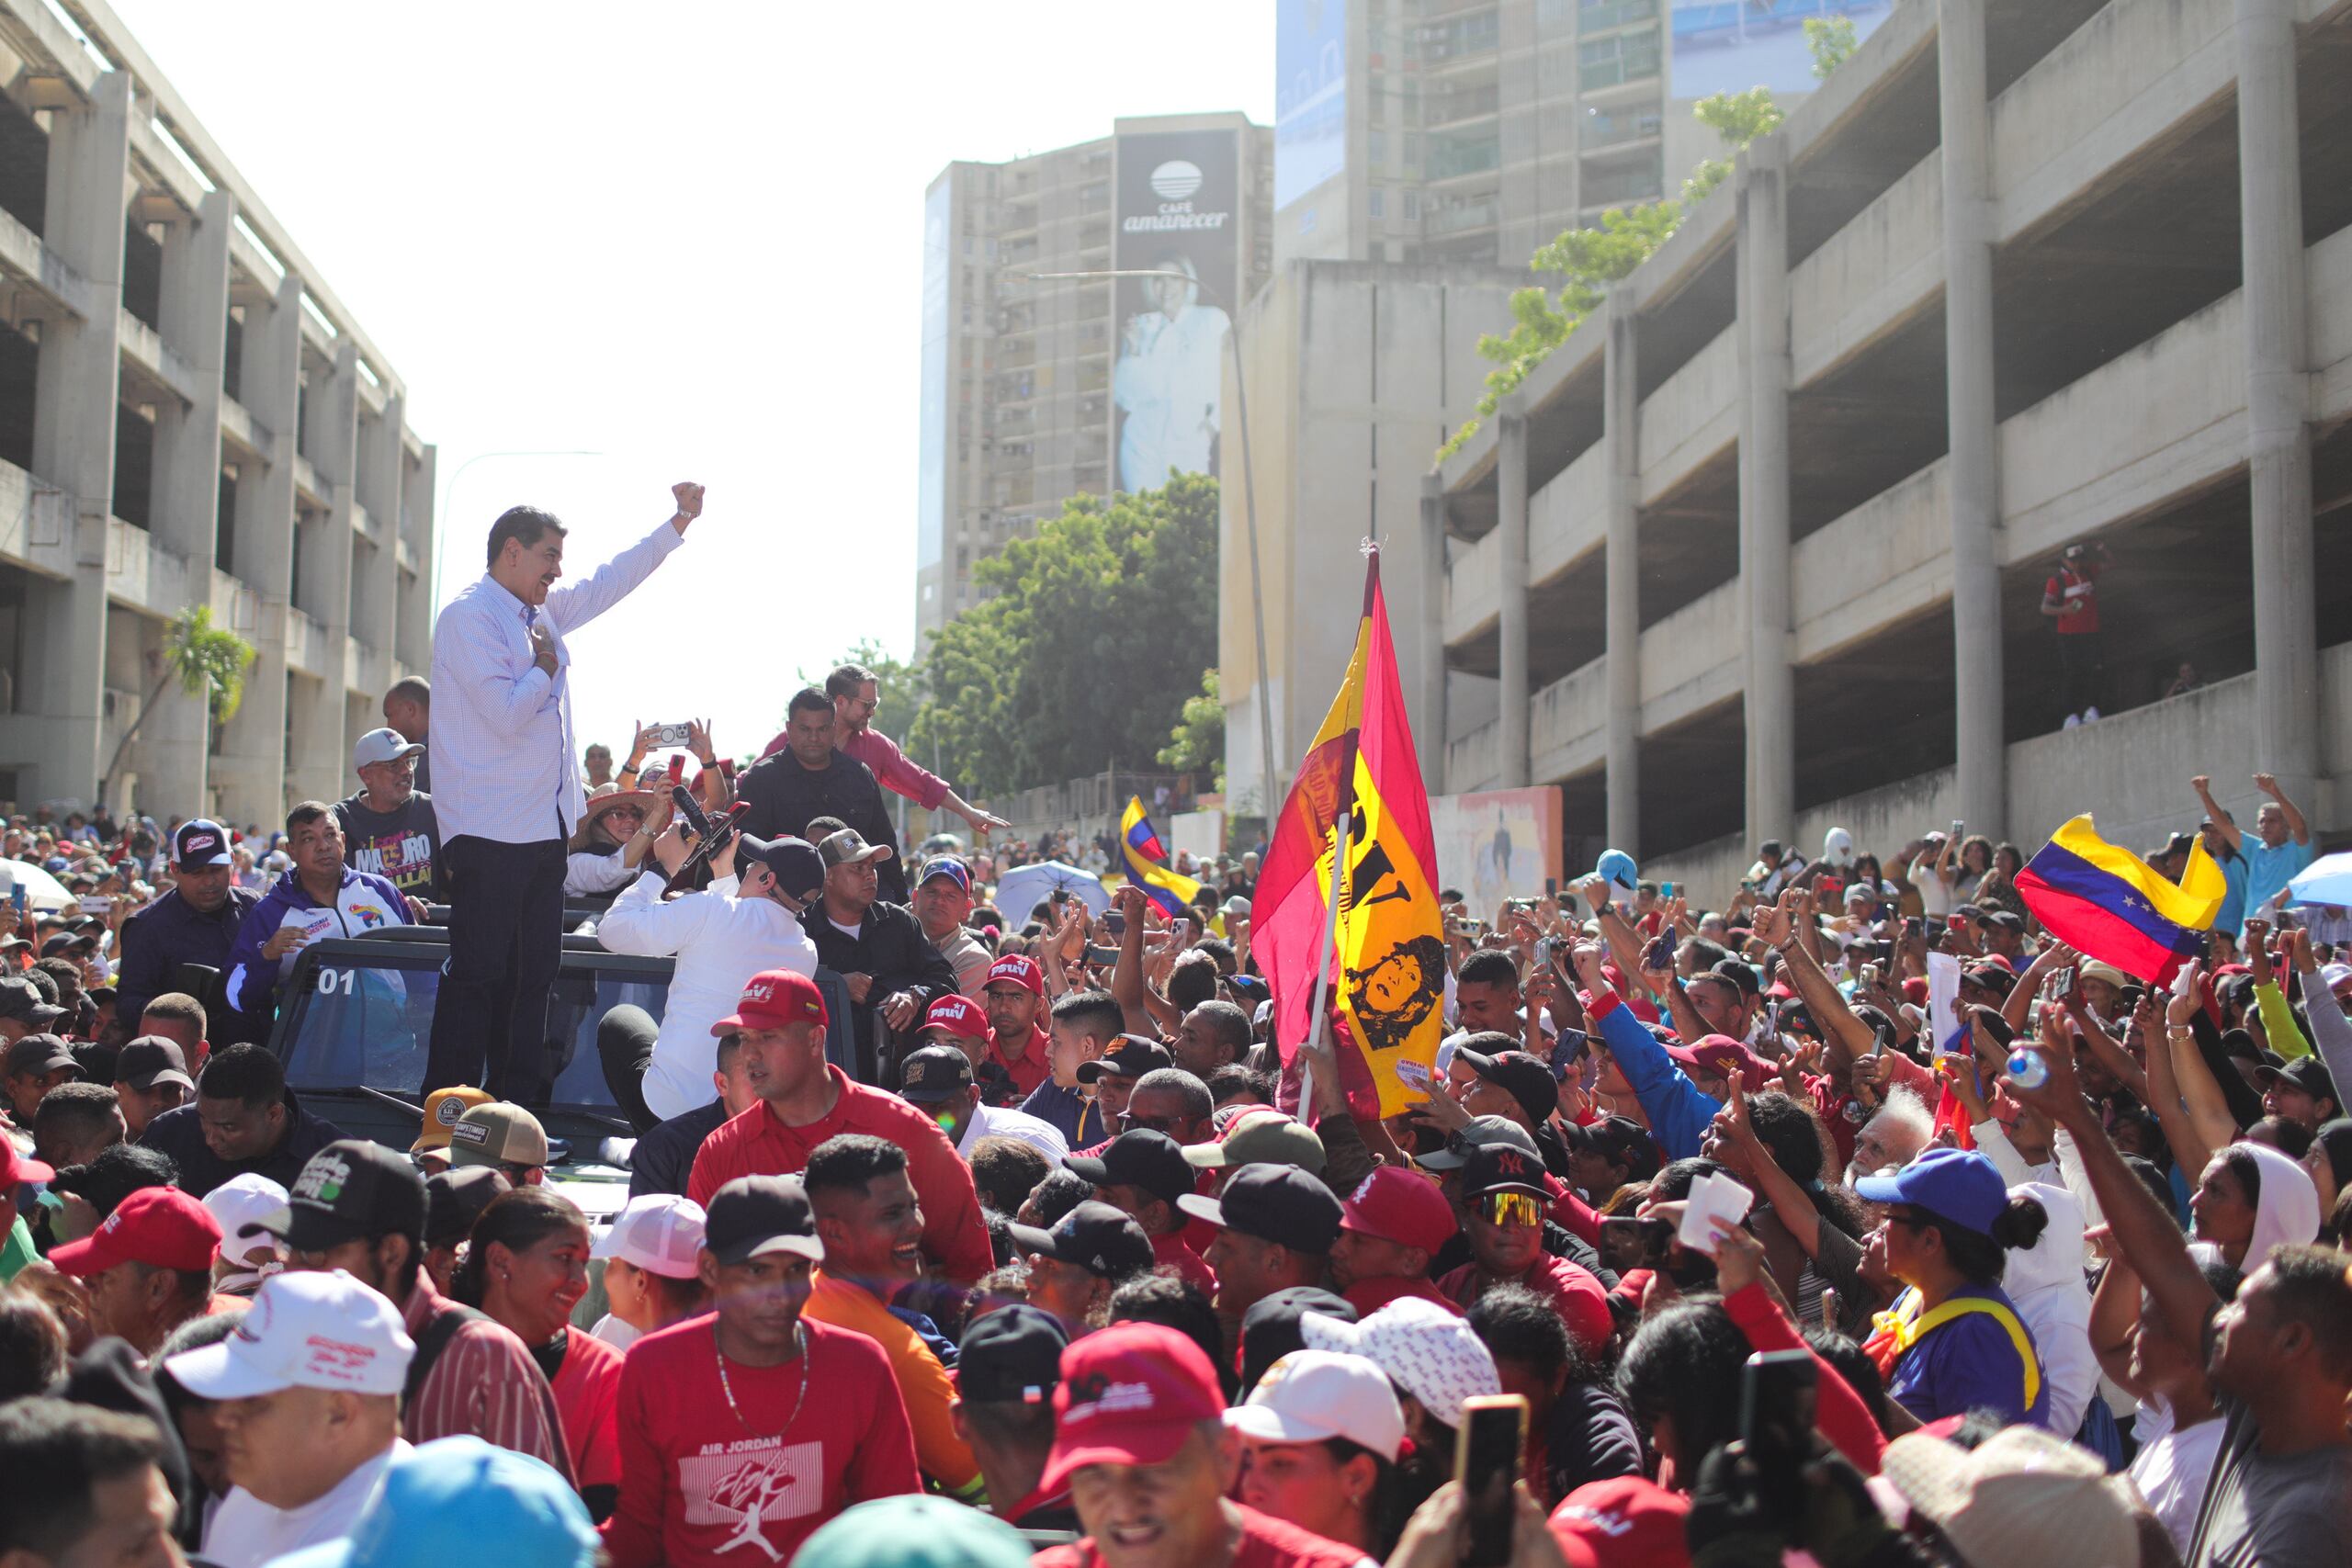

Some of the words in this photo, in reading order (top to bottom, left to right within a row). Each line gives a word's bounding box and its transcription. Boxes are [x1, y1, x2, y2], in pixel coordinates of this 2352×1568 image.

[1123, 212, 1228, 231] amanecer
[318, 968, 356, 995] 01
[700, 1443, 724, 1456] AIR
[726, 1436, 781, 1454] JORDAN
